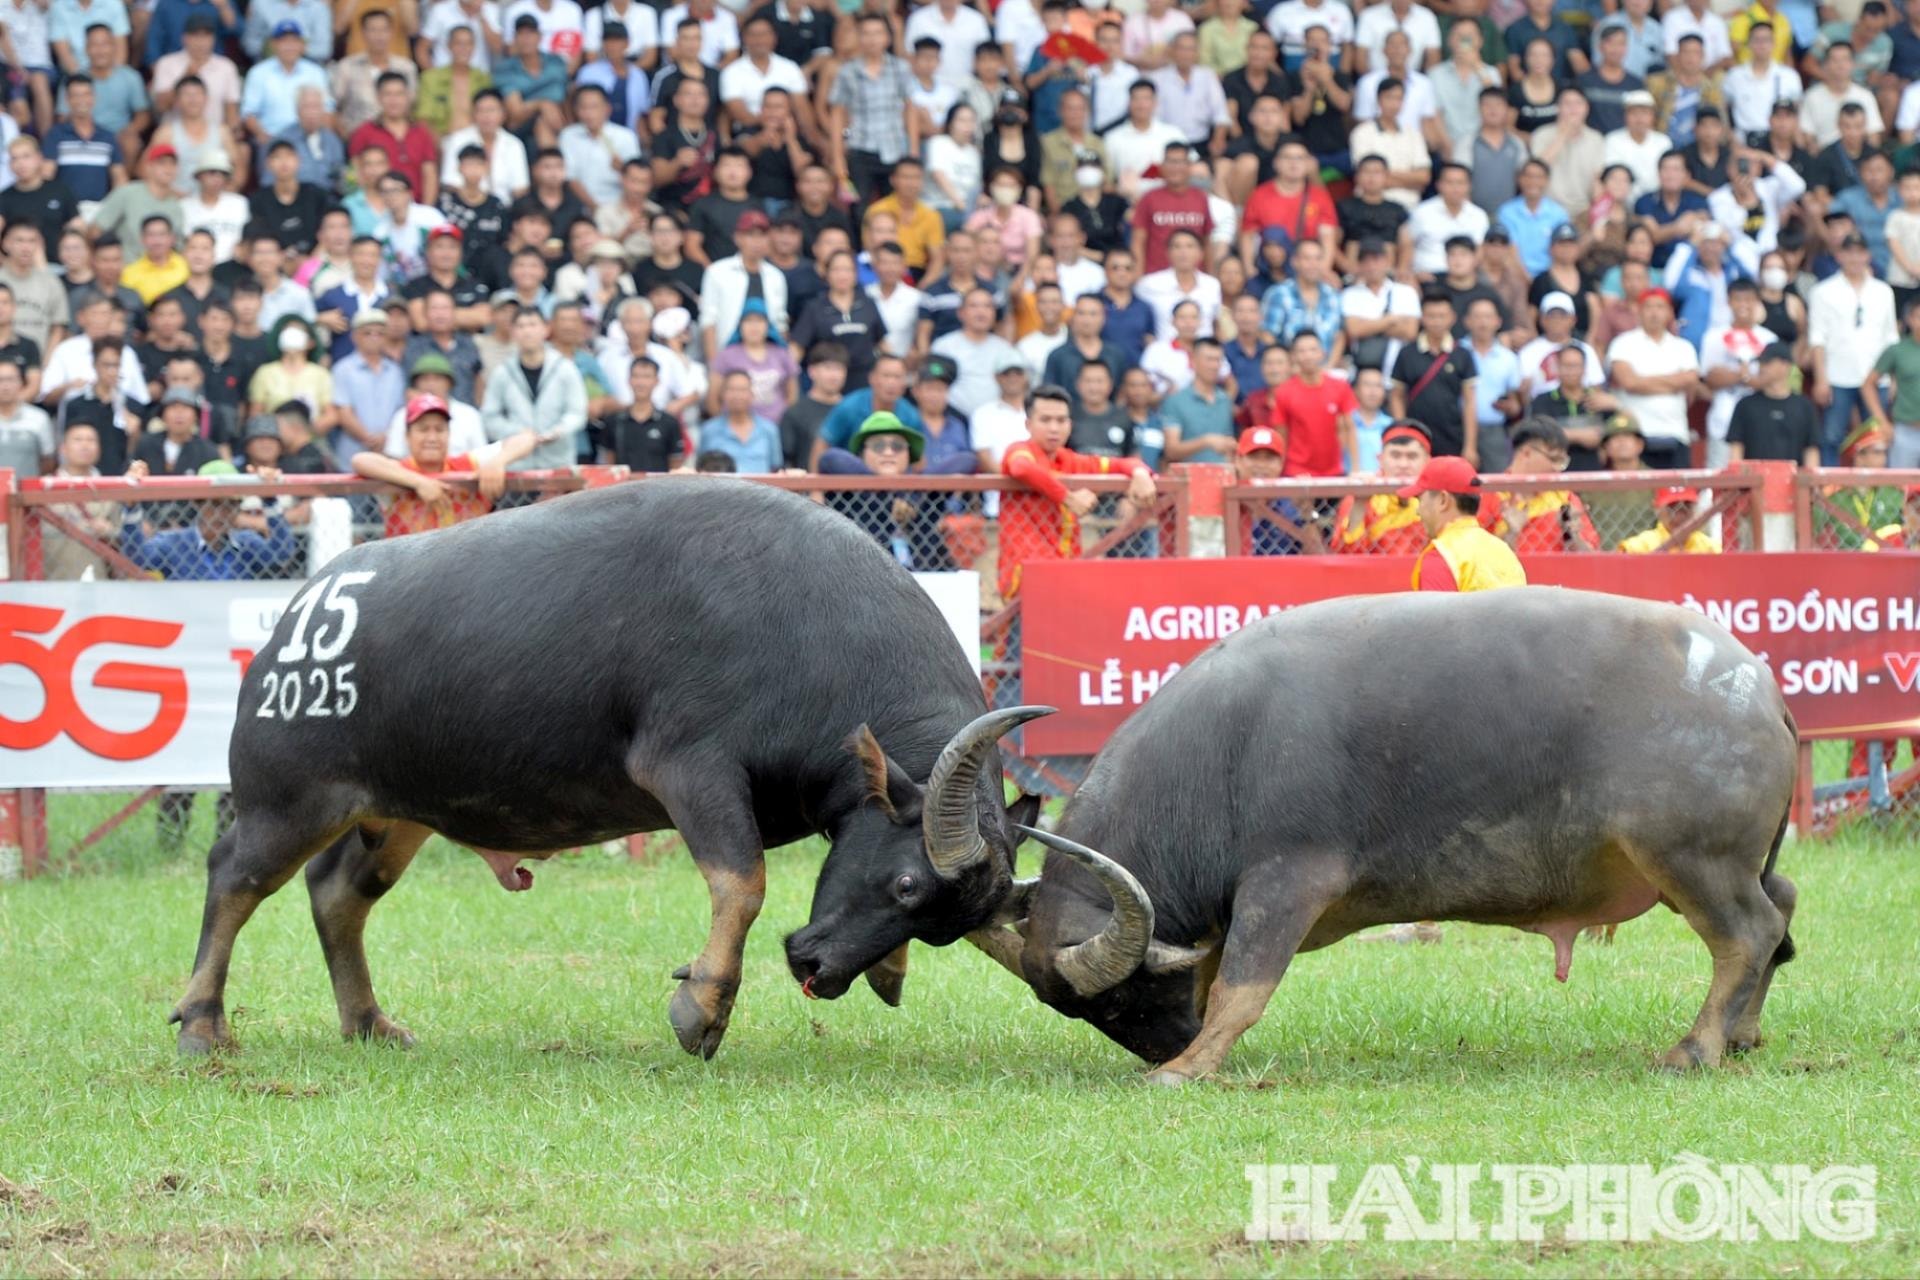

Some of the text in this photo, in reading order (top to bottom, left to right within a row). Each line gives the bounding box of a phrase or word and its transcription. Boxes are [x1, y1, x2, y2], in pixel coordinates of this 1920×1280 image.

[277, 570, 376, 662] 15
[1123, 604, 1294, 640] AGRIBA
[1767, 588, 1880, 633] ĐỒNG
[1887, 597, 1920, 631] H
[256, 662, 358, 721] 2025
[1080, 658, 1123, 705] LỄ
[1781, 656, 1858, 694] SƠN
